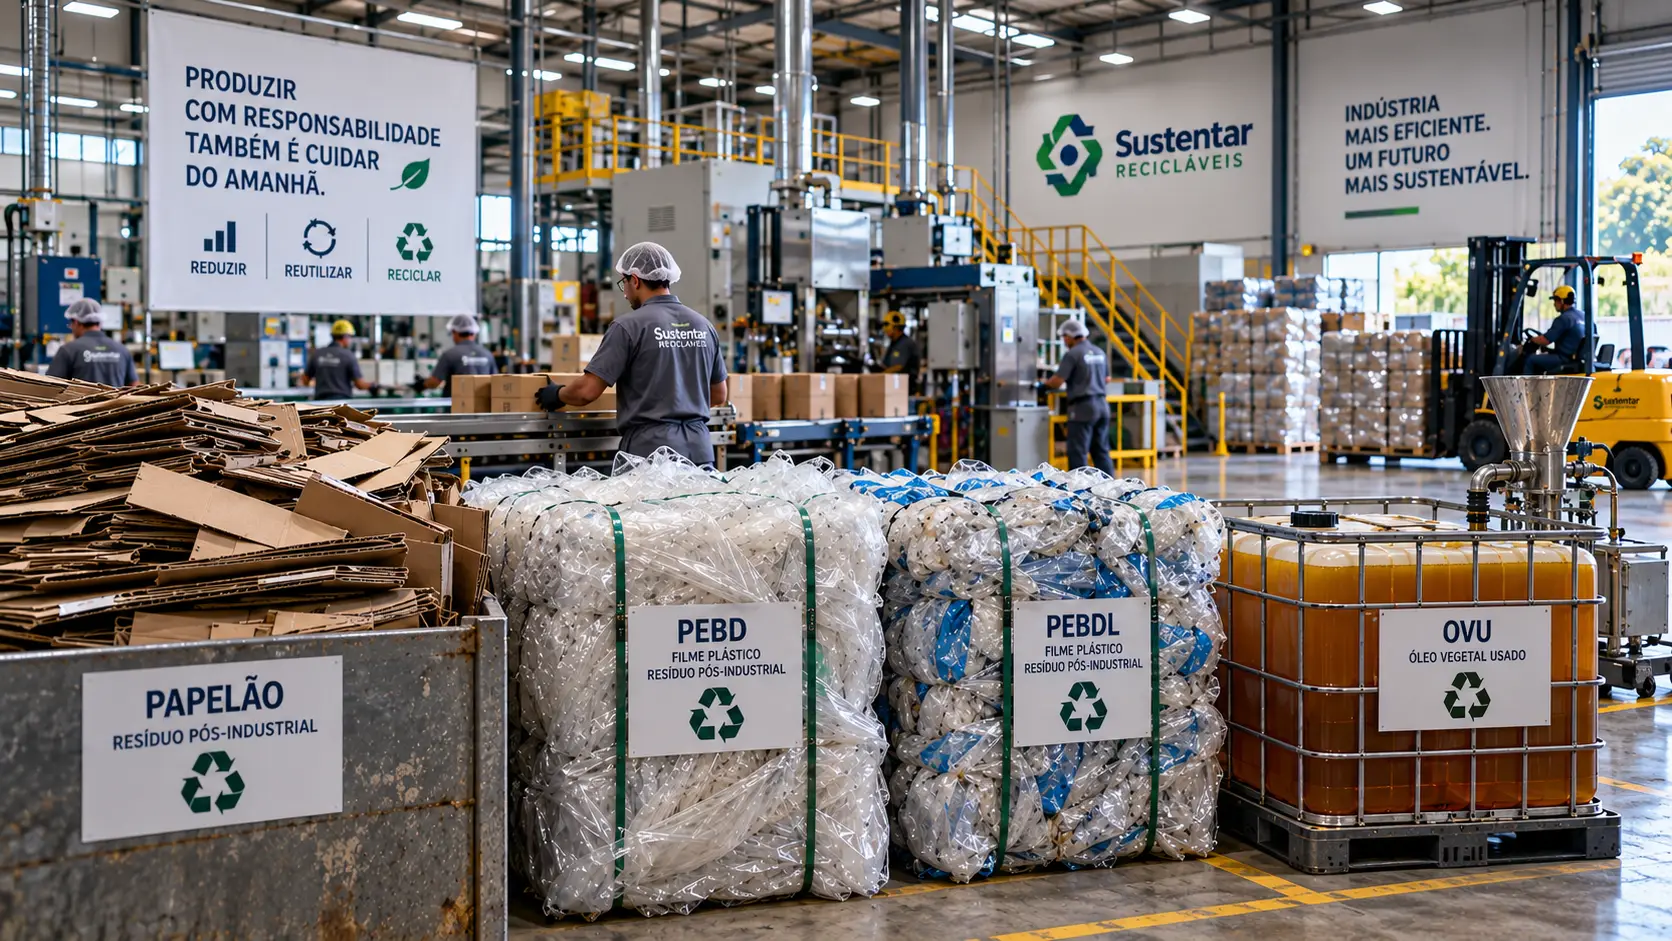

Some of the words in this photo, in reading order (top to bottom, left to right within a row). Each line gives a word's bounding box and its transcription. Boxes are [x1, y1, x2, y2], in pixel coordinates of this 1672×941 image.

[186, 66, 296, 100] PRODUZIR
[1346, 95, 1440, 122] INDÚSTRIA
[186, 99, 235, 124] COM
[245, 105, 441, 147] RESPONSABILIDADE
[1346, 125, 1388, 146] MAIS
[1394, 114, 1490, 141] EFICIENTE.
[185, 132, 279, 161] TAMBÉM
[288, 137, 299, 162] É
[306, 144, 379, 170] CUIDAR
[1116, 121, 1253, 158] Sustentar
[1116, 152, 1243, 178] RECICLÁVEIS
[1346, 152, 1372, 170] UM
[1379, 143, 1450, 167] FUTURO
[187, 165, 217, 188] DO
[225, 169, 324, 195] AMANHÃ.
[1346, 174, 1388, 194] MAIS
[1394, 159, 1530, 191] SUSTENTÁVEL.
[191, 261, 246, 275] REDUZIR
[285, 265, 352, 278] REUTILIZAR
[388, 269, 441, 282] RECICLAR
[654, 326, 707, 340] Sustentar
[679, 618, 746, 644] PEBD
[1047, 613, 1119, 638] PEBDL
[1443, 620, 1491, 643] OVU
[672, 651, 704, 662] FILME
[708, 647, 760, 661] PLÁSTICO
[1046, 645, 1073, 657] FILME
[1077, 643, 1122, 655] PLÁSTICO
[1409, 650, 1437, 663] ÓLEO
[1440, 651, 1486, 662] VEGETAL
[1491, 650, 1526, 661] USADO
[648, 666, 695, 680] RESÍDUO
[699, 664, 786, 677] PÓS-INDUSTRIAL
[1025, 660, 1065, 673] RESÍDUO
[1068, 658, 1143, 671] PÓS-INDUSTRIAL
[147, 675, 283, 719] PAPELÃO
[113, 729, 183, 750] RESÍDUO
[190, 719, 318, 743] PÓS-INDUSTRIAL
